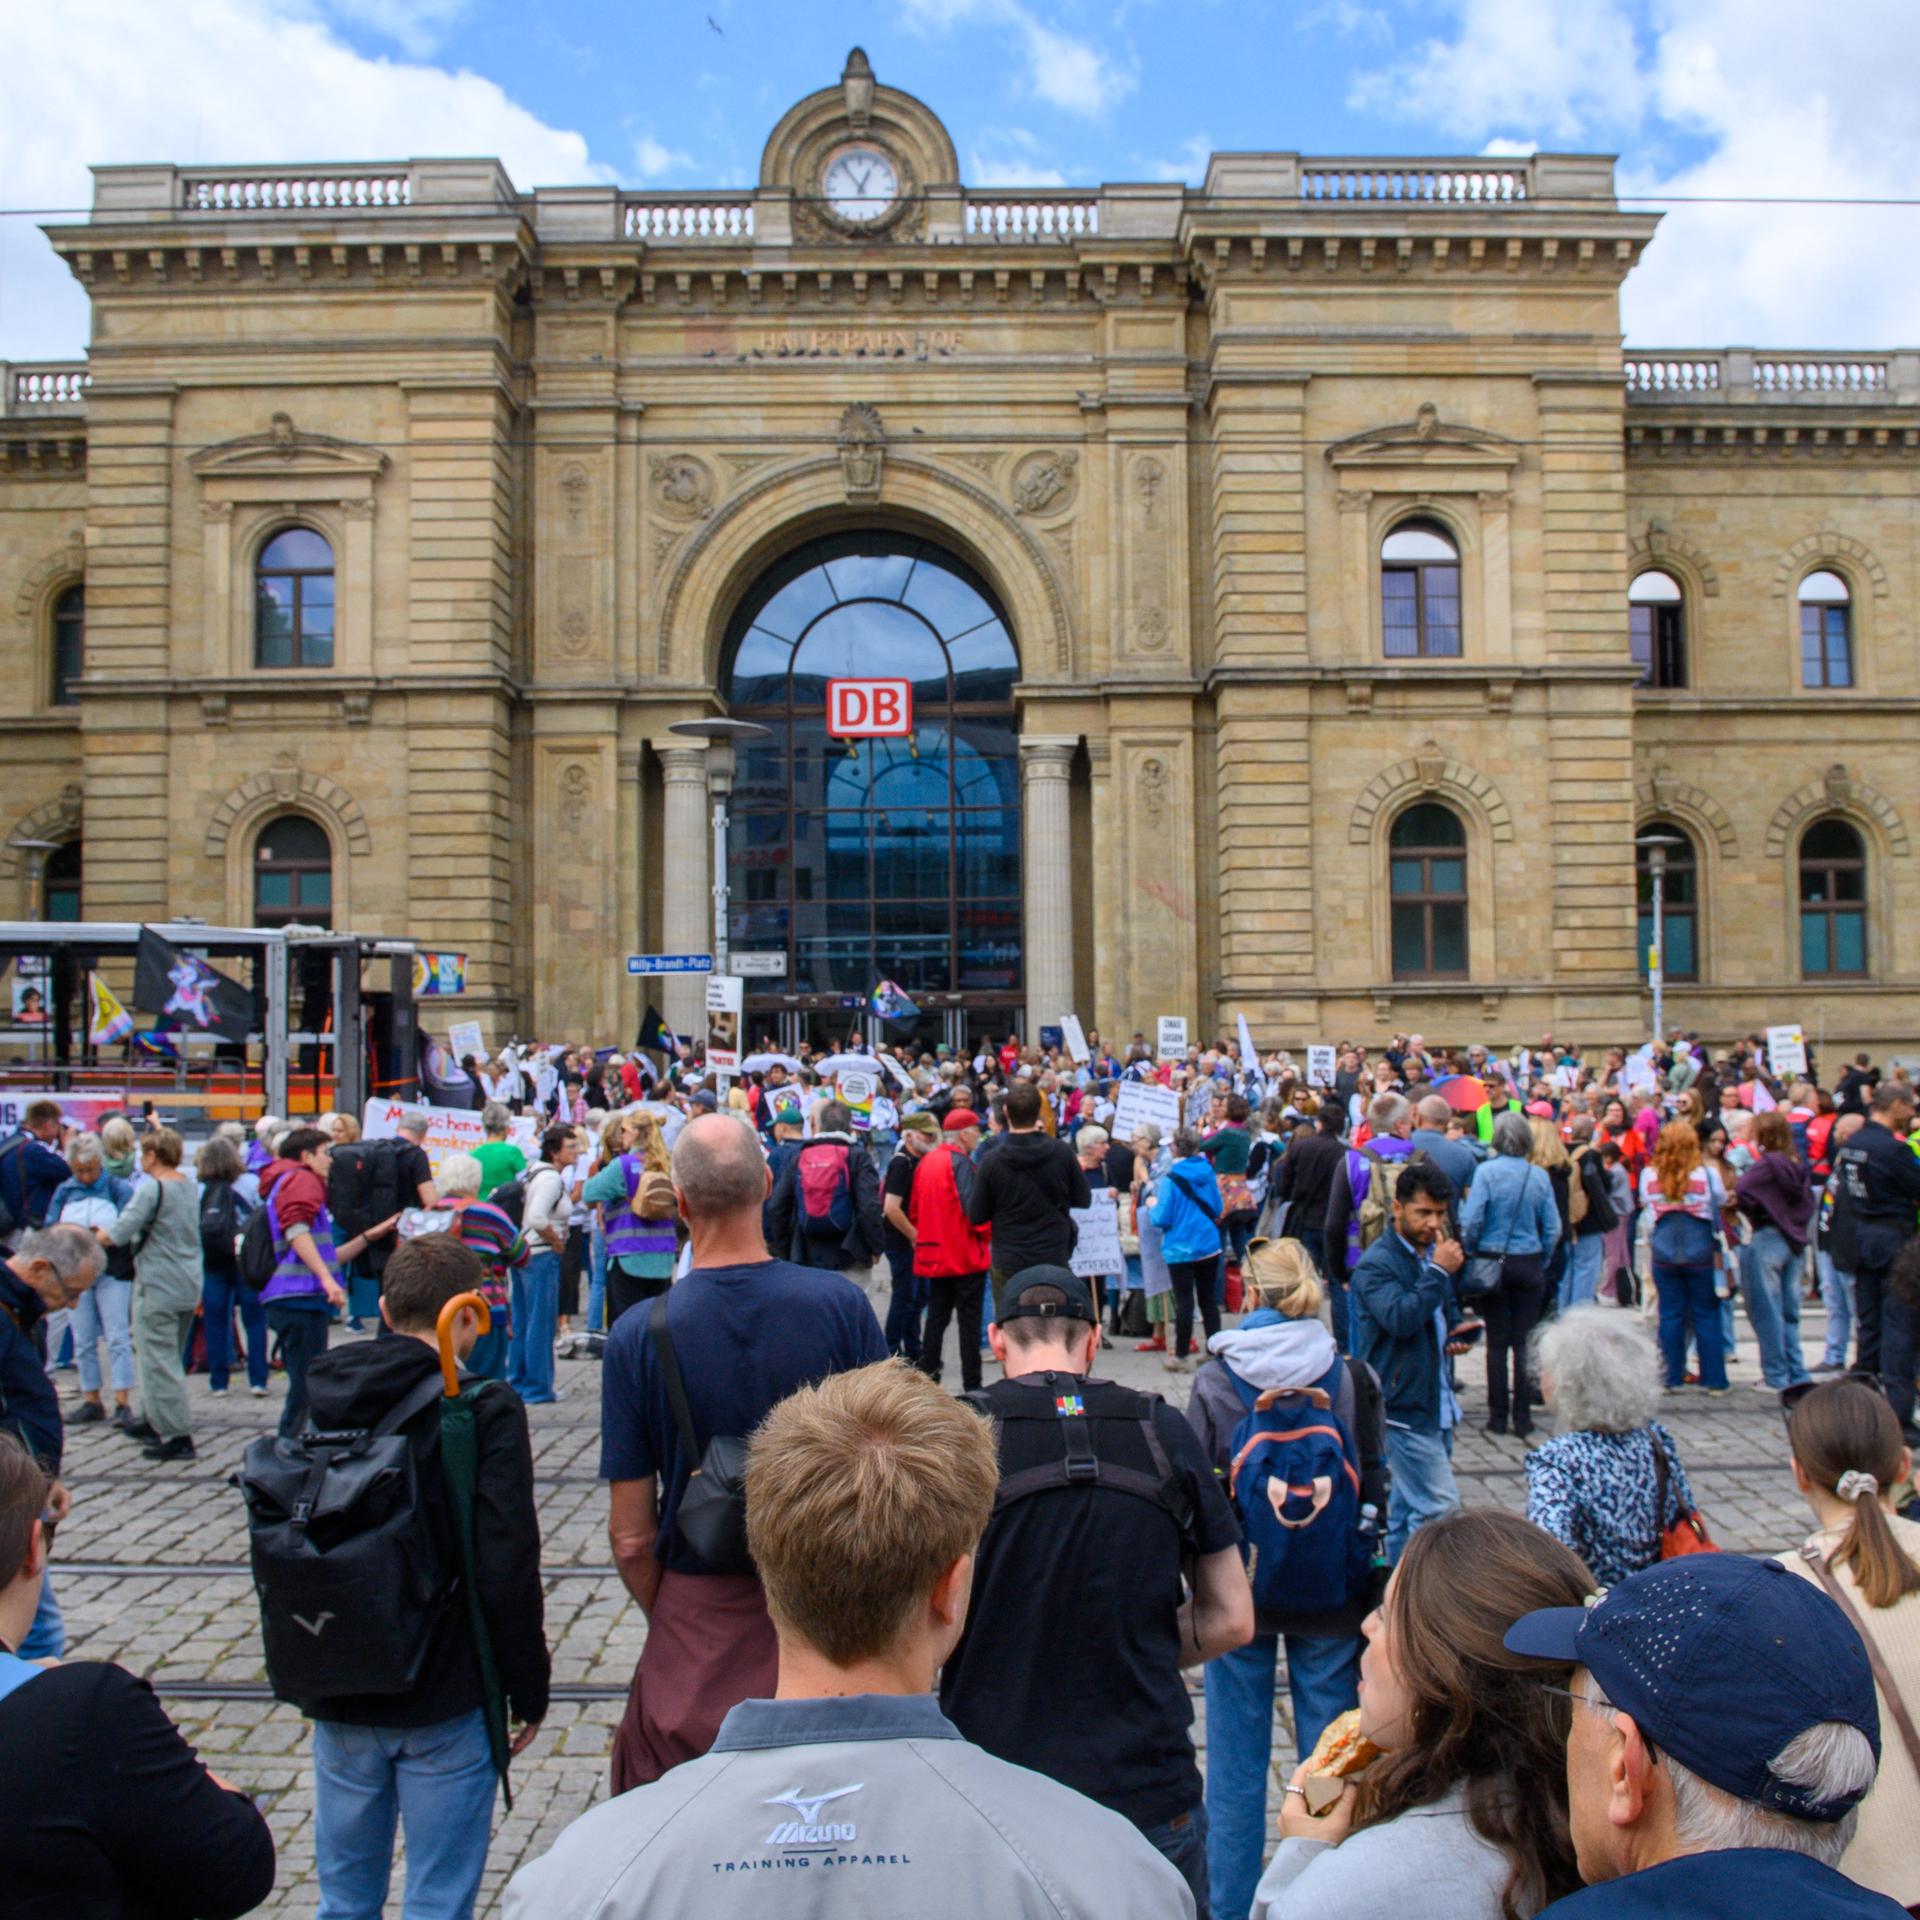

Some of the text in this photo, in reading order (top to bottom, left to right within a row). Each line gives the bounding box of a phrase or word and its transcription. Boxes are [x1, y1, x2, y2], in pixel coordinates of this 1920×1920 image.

[839, 688, 900, 726] DB
[629, 956, 711, 972] Willy-Brandt-Platz
[712, 1854, 911, 1873] TRAINING APPAREL
